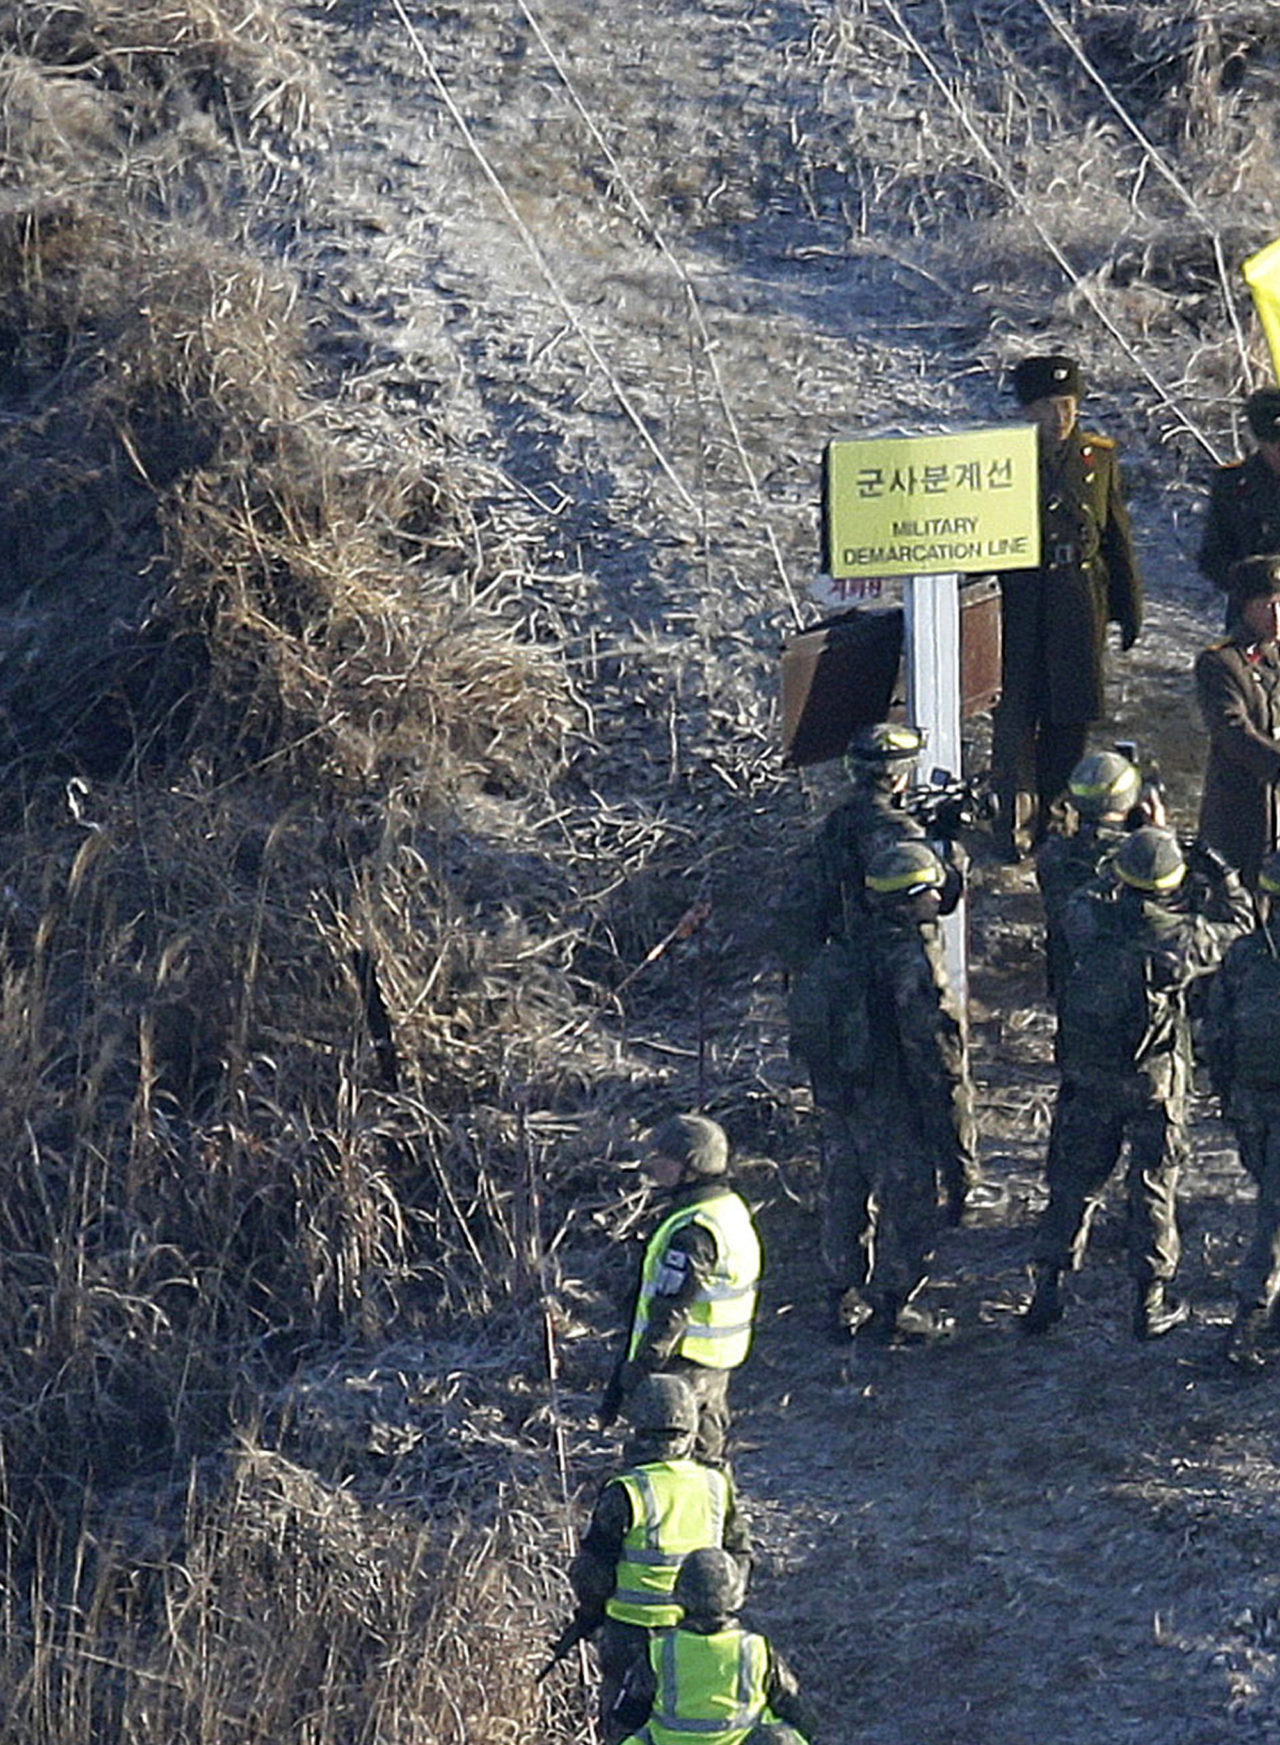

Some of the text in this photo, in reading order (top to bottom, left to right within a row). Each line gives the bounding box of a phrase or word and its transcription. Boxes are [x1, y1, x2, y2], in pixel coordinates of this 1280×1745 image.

[856, 458, 1013, 498] 군사분계선
[892, 517, 979, 537] MILITARY
[843, 536, 1029, 566] DEMARCATION LINE
